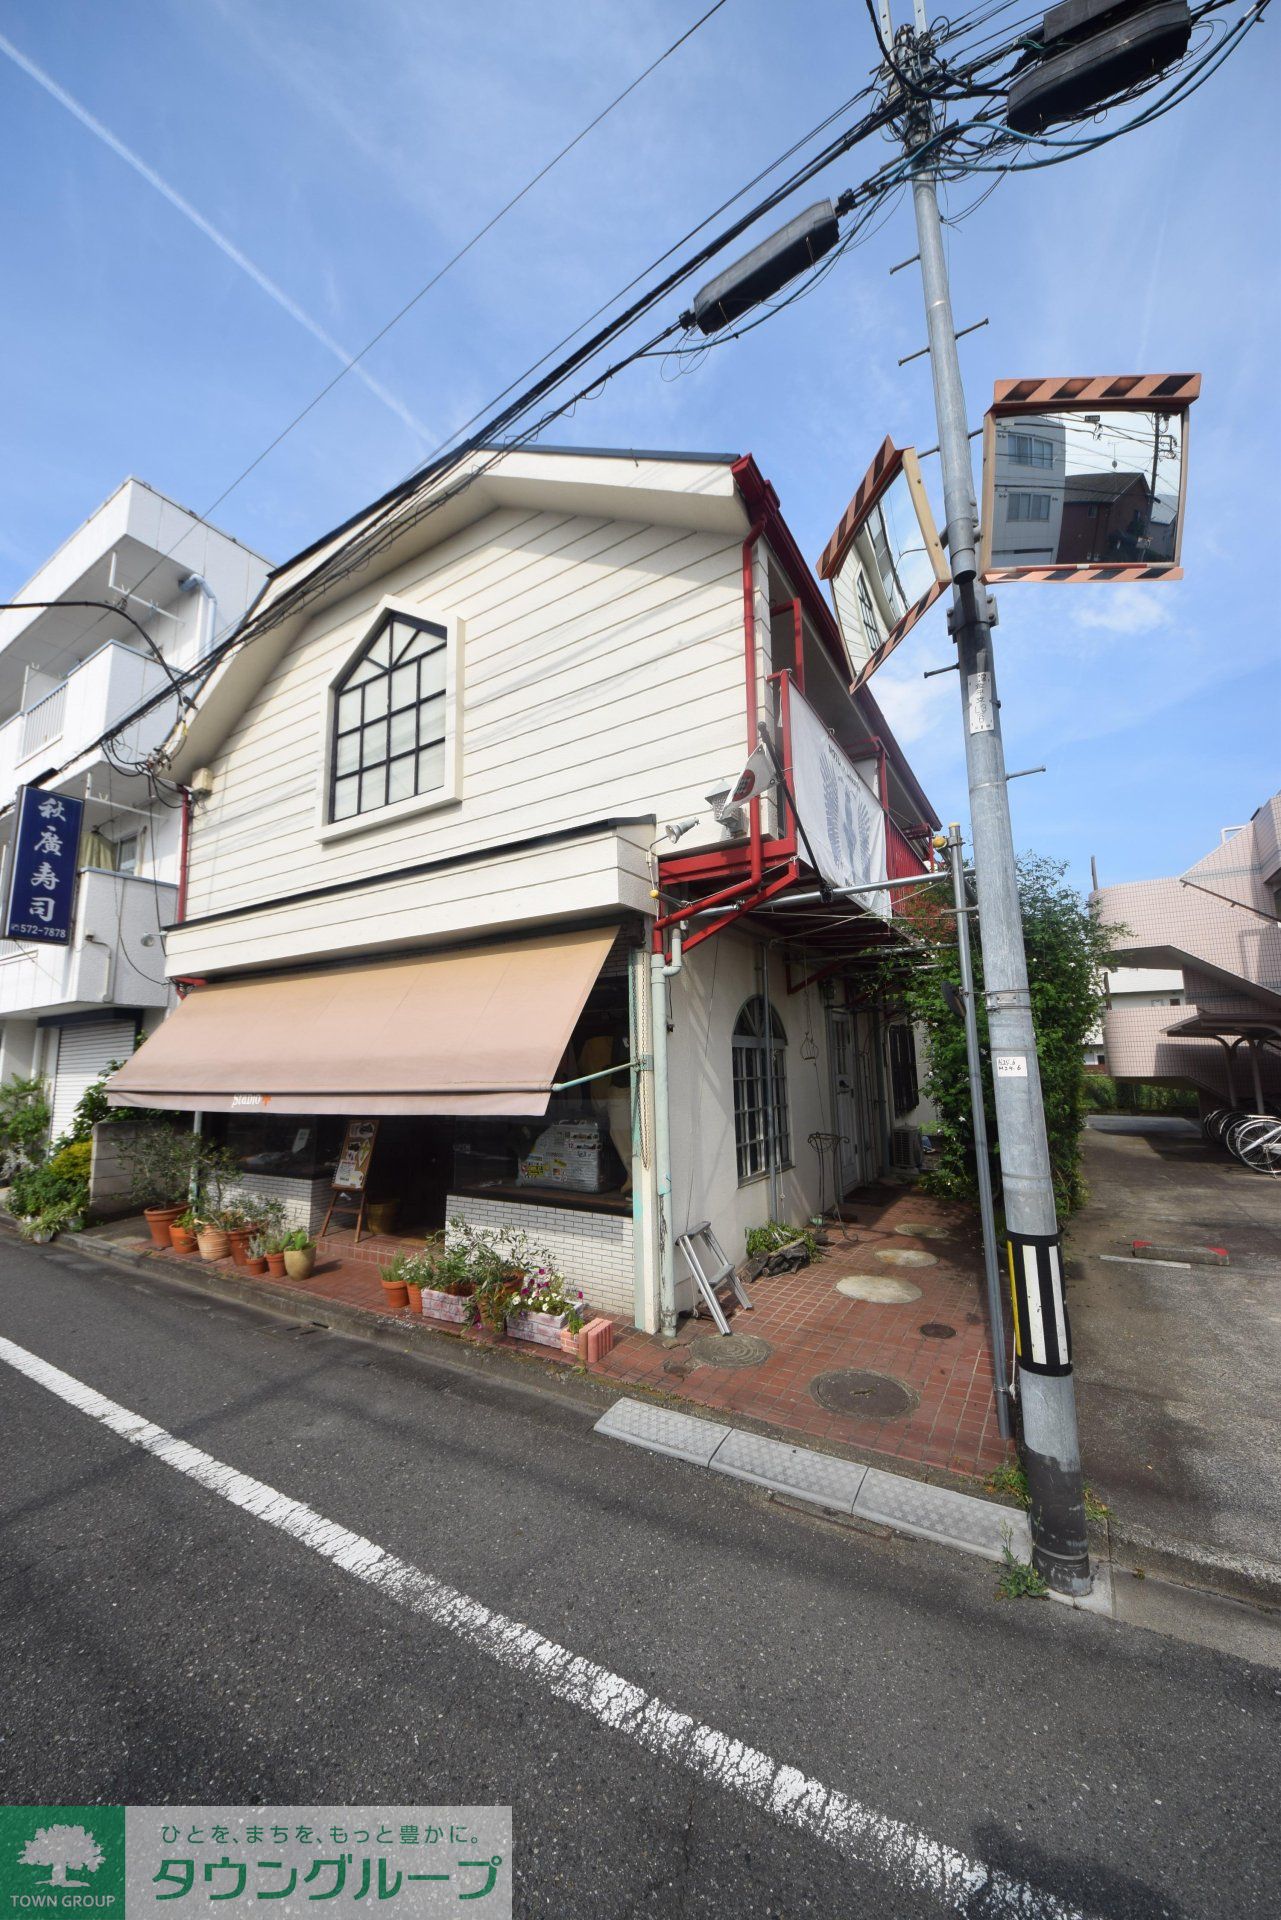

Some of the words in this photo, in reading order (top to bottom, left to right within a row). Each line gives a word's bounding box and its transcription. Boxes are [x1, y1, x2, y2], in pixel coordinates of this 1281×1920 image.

[28, 797, 67, 922] 秋廣寿司
[20, 923, 67, 938] 572-7878
